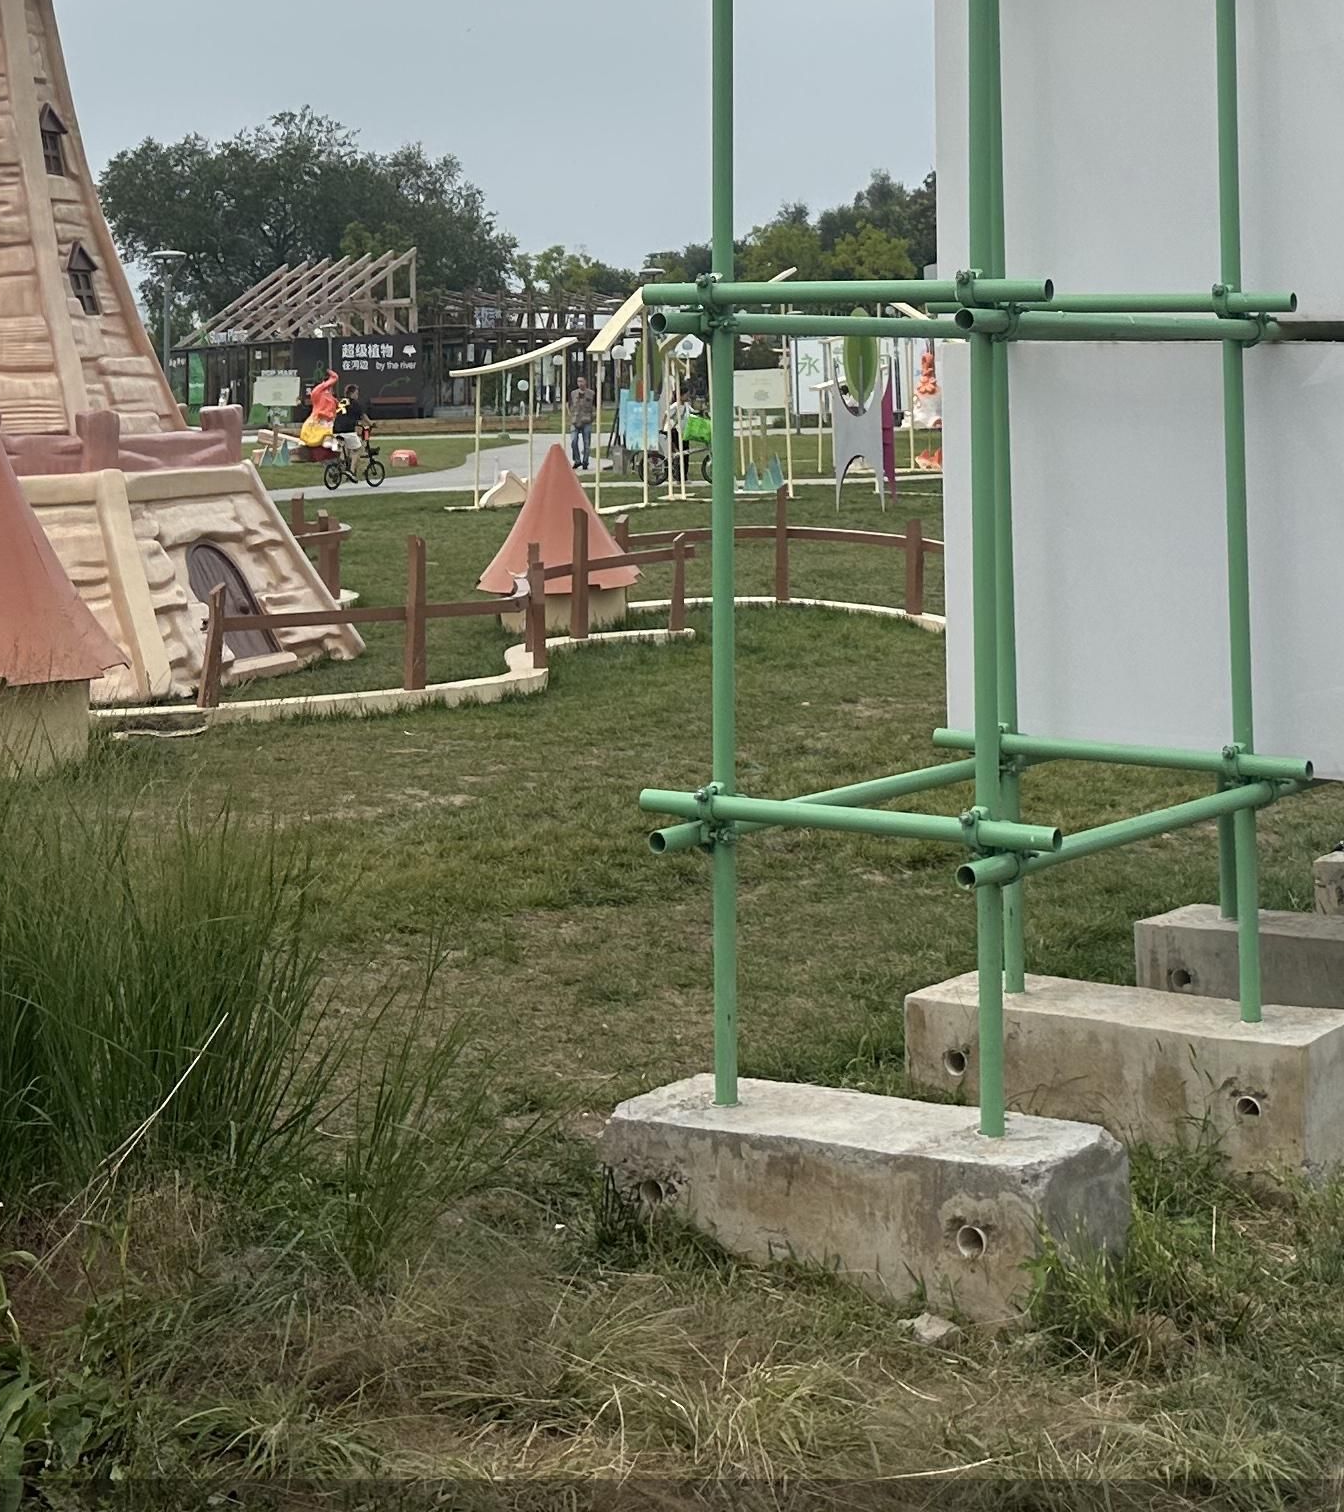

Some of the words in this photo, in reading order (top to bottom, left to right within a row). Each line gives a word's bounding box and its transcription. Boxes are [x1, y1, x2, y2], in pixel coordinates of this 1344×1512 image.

[341, 343, 394, 358] 超级植物
[376, 361, 385, 371] by
[387, 361, 399, 369] the
[400, 361, 416, 369] river
